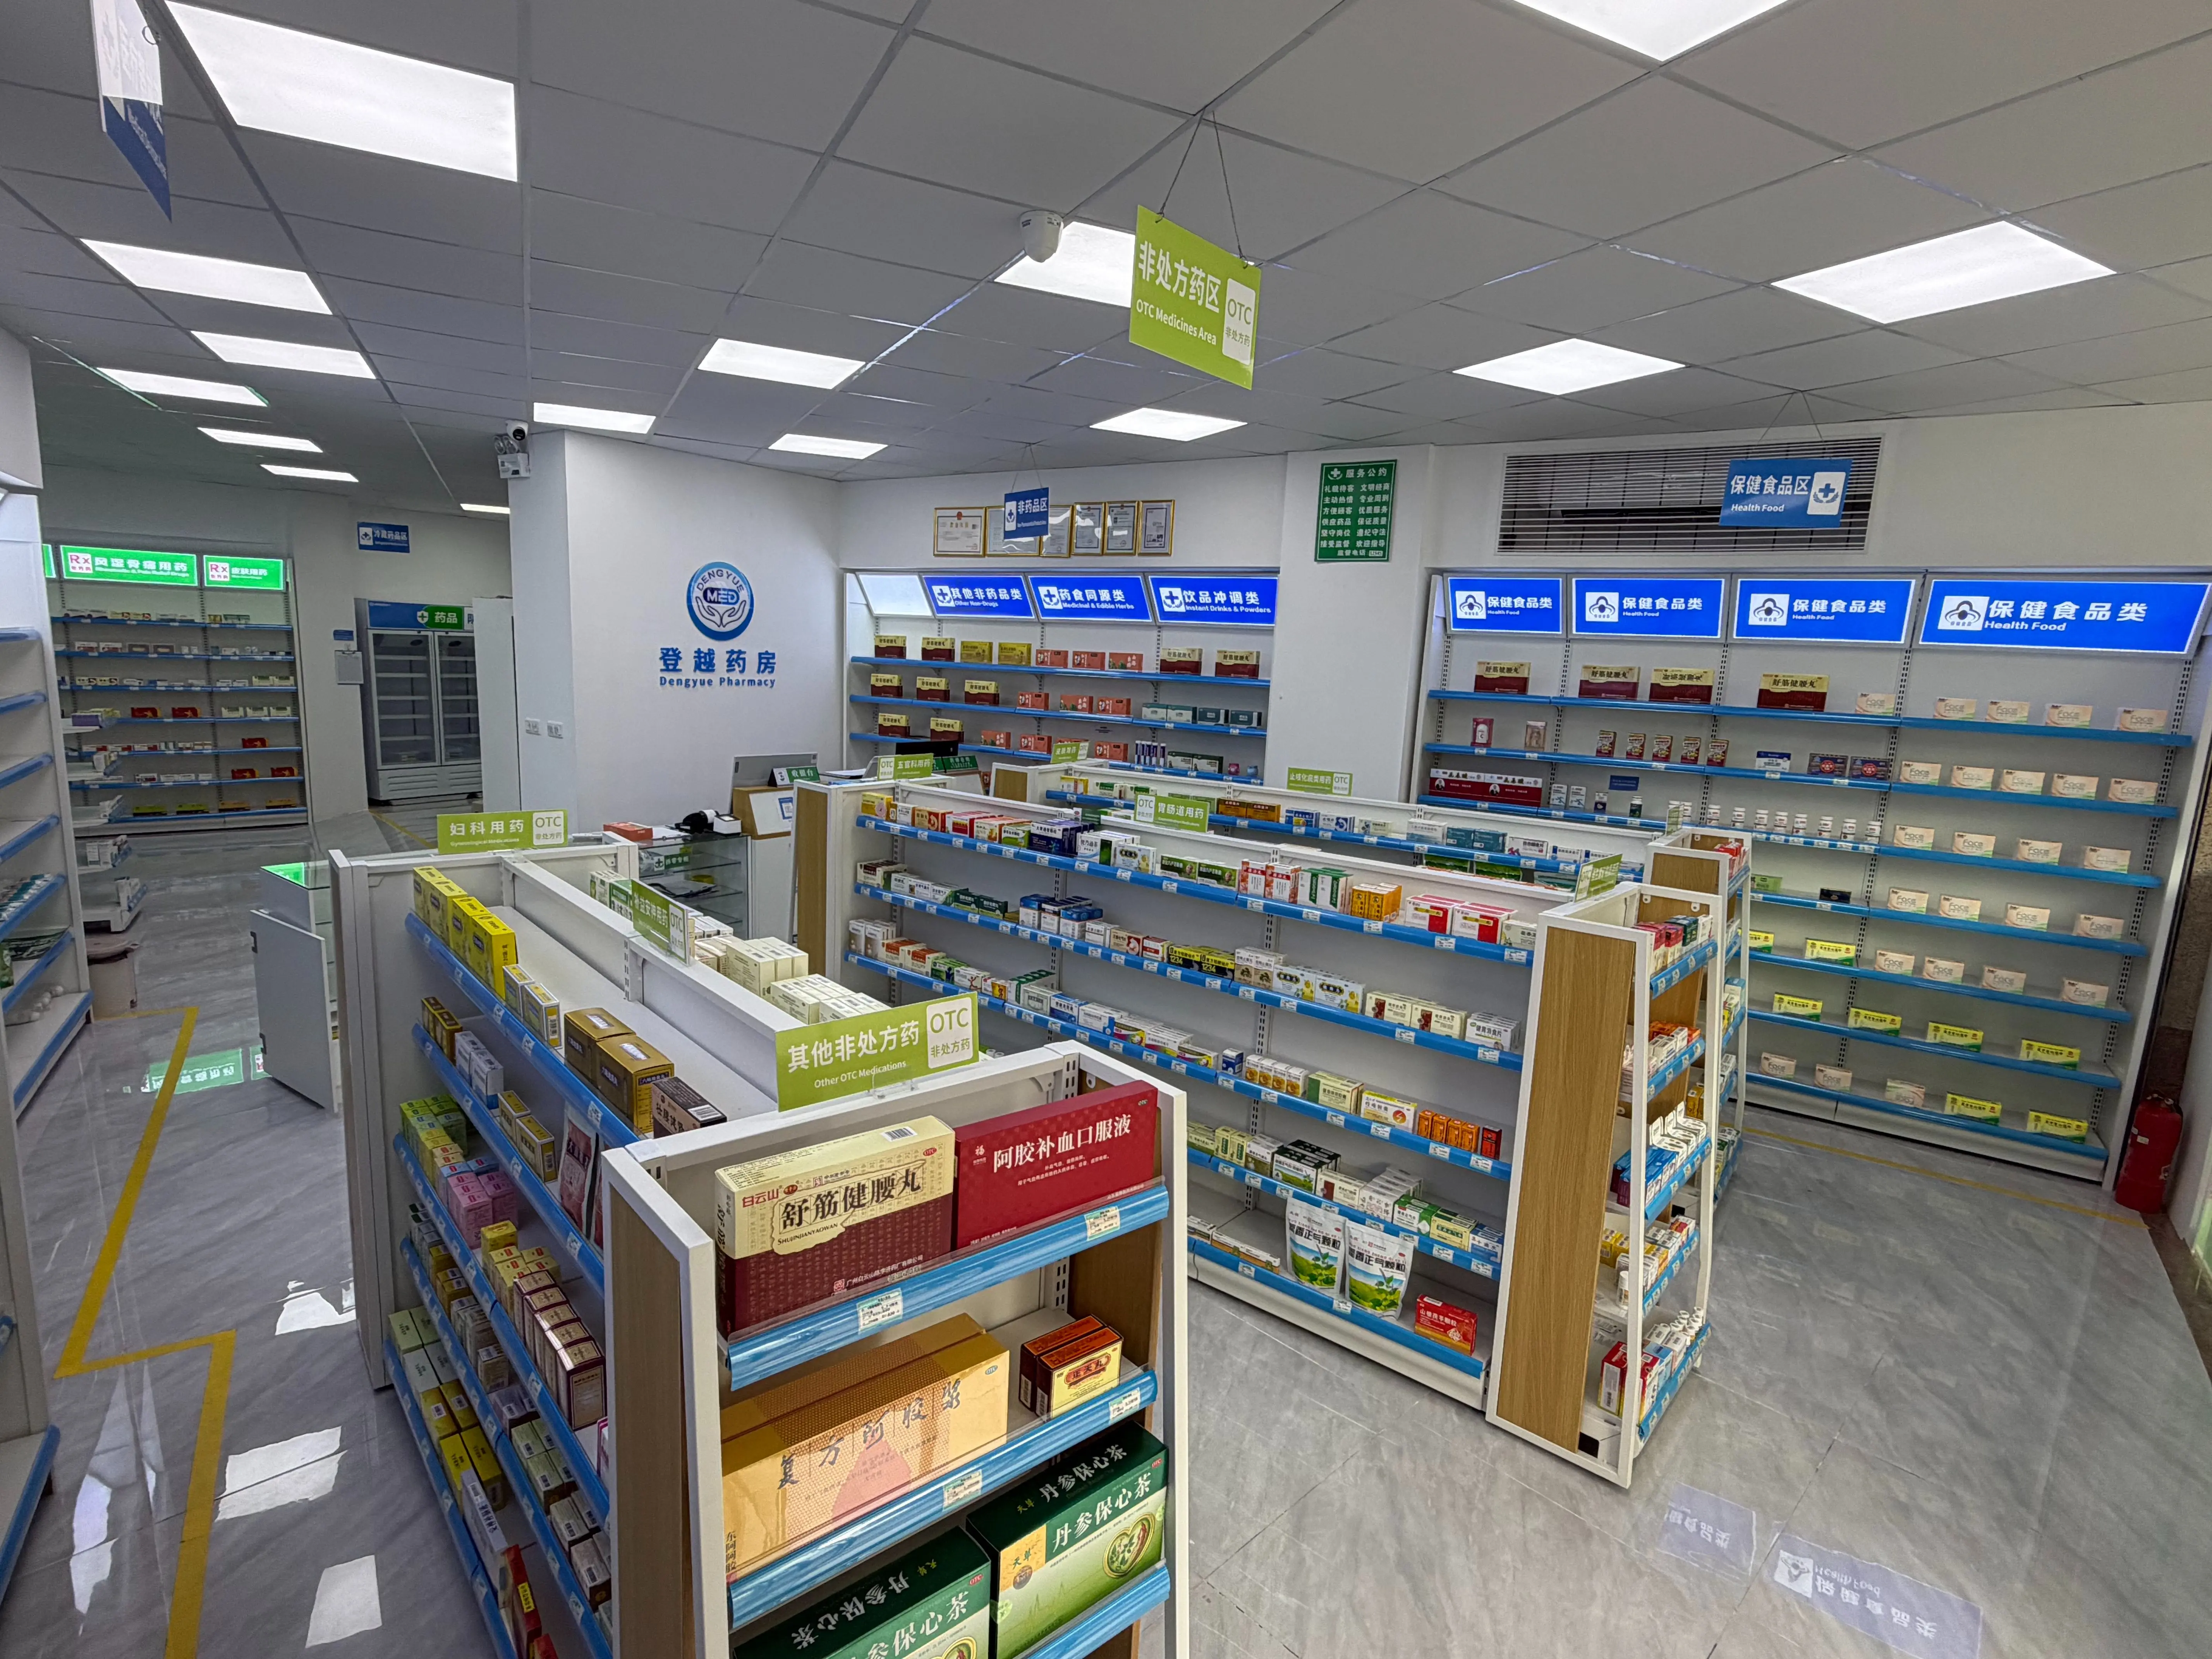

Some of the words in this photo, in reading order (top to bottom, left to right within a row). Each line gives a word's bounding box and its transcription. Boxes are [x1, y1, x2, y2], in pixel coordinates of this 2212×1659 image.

[1139, 240, 1221, 313] 非处方药区
[1228, 299, 1252, 325] OTC
[1136, 299, 1154, 318] OTC
[1156, 309, 1197, 337] Medicines
[1198, 326, 1216, 345] Area
[1225, 326, 1250, 347] 非处方药
[1346, 467, 1387, 478] 服务公约
[1731, 475, 1811, 495] 保健食品区
[1017, 498, 1048, 514] 非药品区
[1731, 503, 1760, 512] Health
[70, 554, 90, 564] Rx
[210, 564, 228, 574] Rx
[697, 569, 745, 593] DENGYUE
[707, 590, 737, 603] MED
[952, 587, 1023, 600] 其他非药品类
[1059, 589, 1125, 602] 药食同源类
[1183, 590, 1260, 605] 饮品冲调类
[1487, 596, 1553, 609] 保健食品类
[1623, 597, 1703, 611] 保健食品类
[1793, 599, 1886, 614] 保健食品类
[434, 611, 458, 623] 药品
[1989, 599, 2147, 622] 保健食品类
[1984, 620, 2029, 630] Health
[2032, 622, 2066, 631] Food
[659, 647, 776, 674] 登越药房
[1485, 666, 1518, 674] 舒筋健腰丸
[659, 676, 713, 688] Dengyue
[720, 677, 775, 689] Pharmacy
[1772, 678, 1816, 688] 舒筋健腰丸
[897, 760, 930, 770] 五官科用药
[1334, 776, 1348, 784] OTC
[1139, 799, 1154, 809] OTC
[1158, 802, 1204, 820] 胃肠道用药
[450, 819, 524, 836] 妇科用药
[535, 817, 562, 828] OTC
[671, 912, 683, 933] OTC
[2016, 912, 2037, 920] Face
[1170, 956, 1182, 965] 1234
[1202, 963, 1216, 972] 1234
[931, 1008, 969, 1033] OTC
[1476, 1025, 1501, 1036] 健胃消食片
[788, 1020, 919, 1073] 其他非处方药
[931, 1037, 970, 1058] 非处方药
[1768, 1062, 1785, 1070] Face
[814, 1077, 838, 1088] Other
[840, 1071, 857, 1082] OTC
[859, 1060, 906, 1078] Medications
[994, 1114, 1131, 1173] 阿胶补血口服液
[742, 1188, 779, 1208] 白云山
[781, 1168, 921, 1230] 舒筋健腰丸
[1072, 1359, 1104, 1379] 正天丸
[778, 1379, 961, 1489] 复方阿胶浆
[1040, 1444, 1127, 1503] 丹参保心茶
[1053, 1472, 1151, 1553] 丹参保心茶
[792, 1571, 909, 1650] 丹参保心茶
